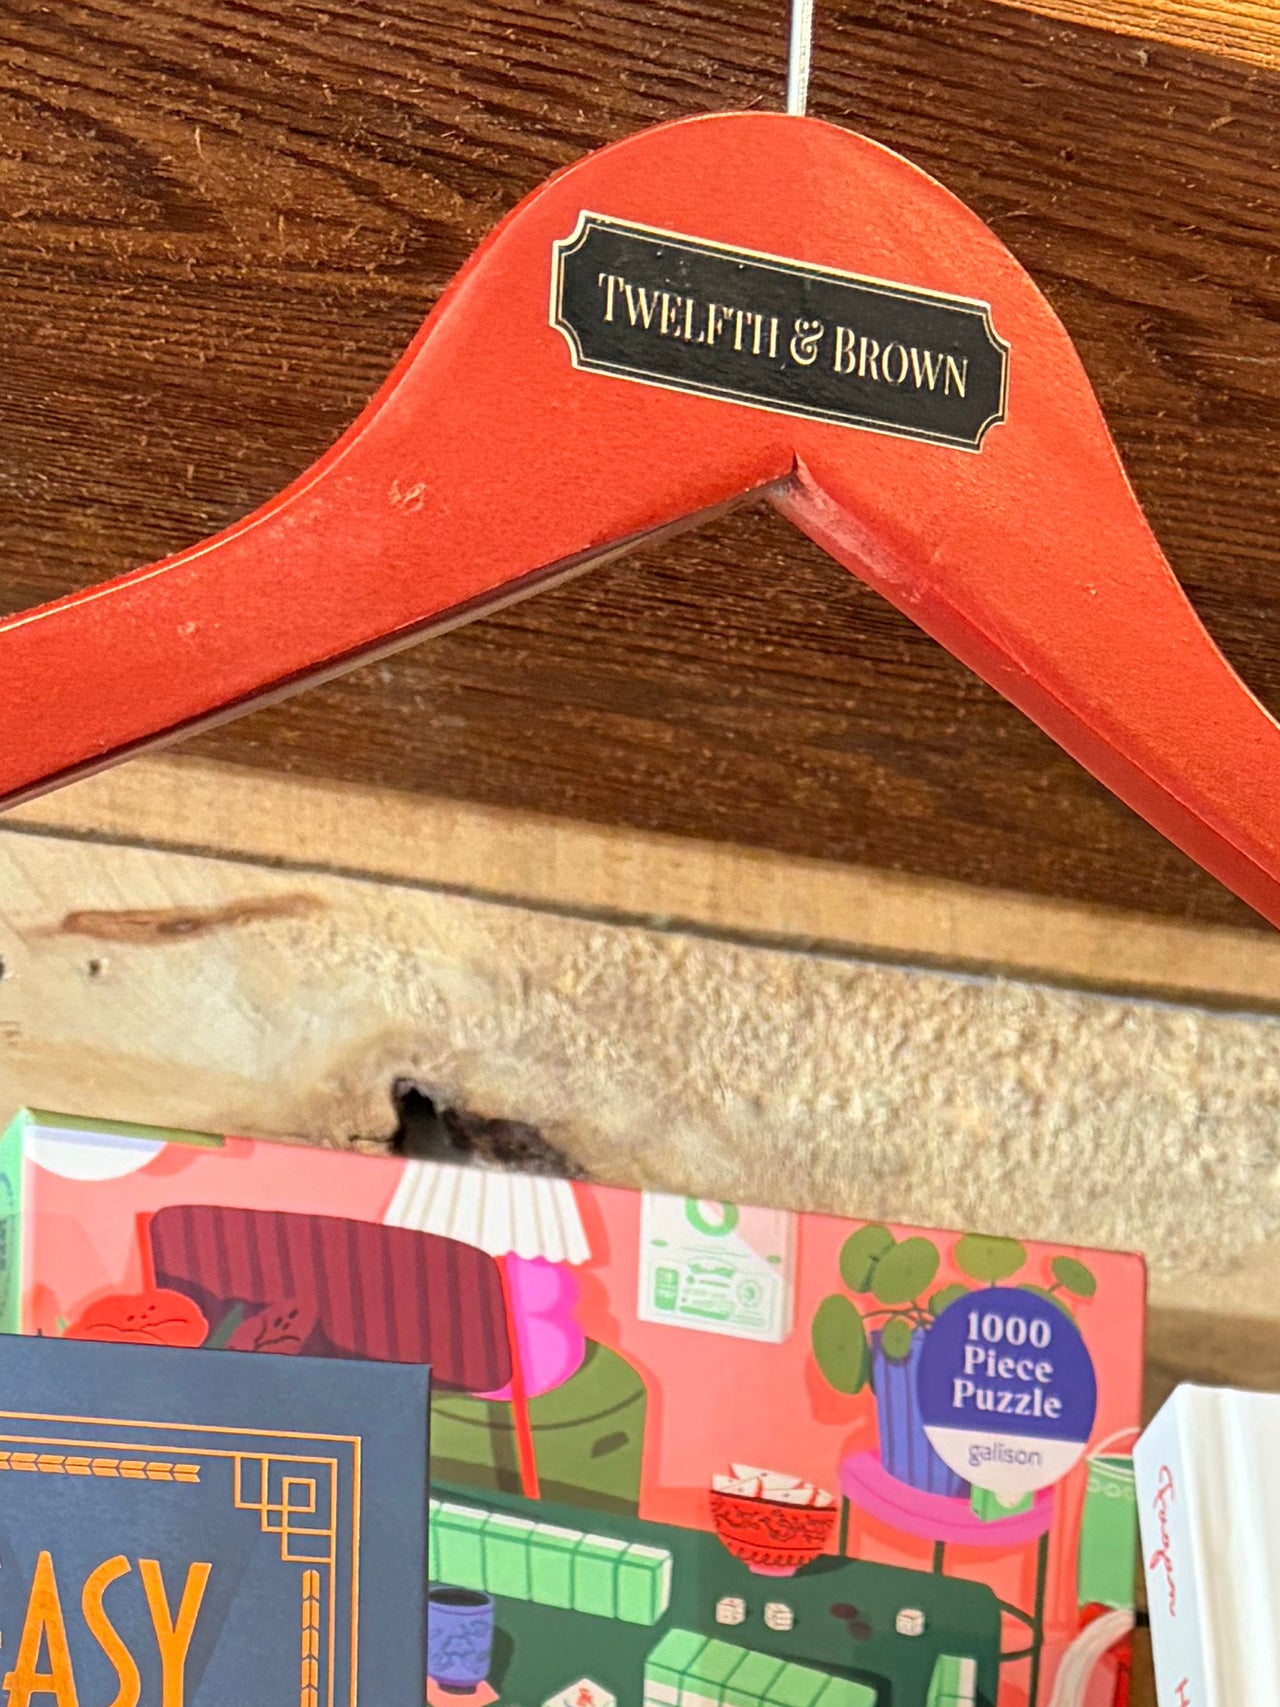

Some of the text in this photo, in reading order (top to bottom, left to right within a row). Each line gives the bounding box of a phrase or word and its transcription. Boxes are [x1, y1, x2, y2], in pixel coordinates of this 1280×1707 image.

[597, 272, 970, 399] TWELFTH & BROWN
[966, 1310, 1052, 1349] 1000
[964, 1344, 1054, 1384] Piece
[951, 1378, 1063, 1419] Puzzle
[967, 1441, 1042, 1467] galison
